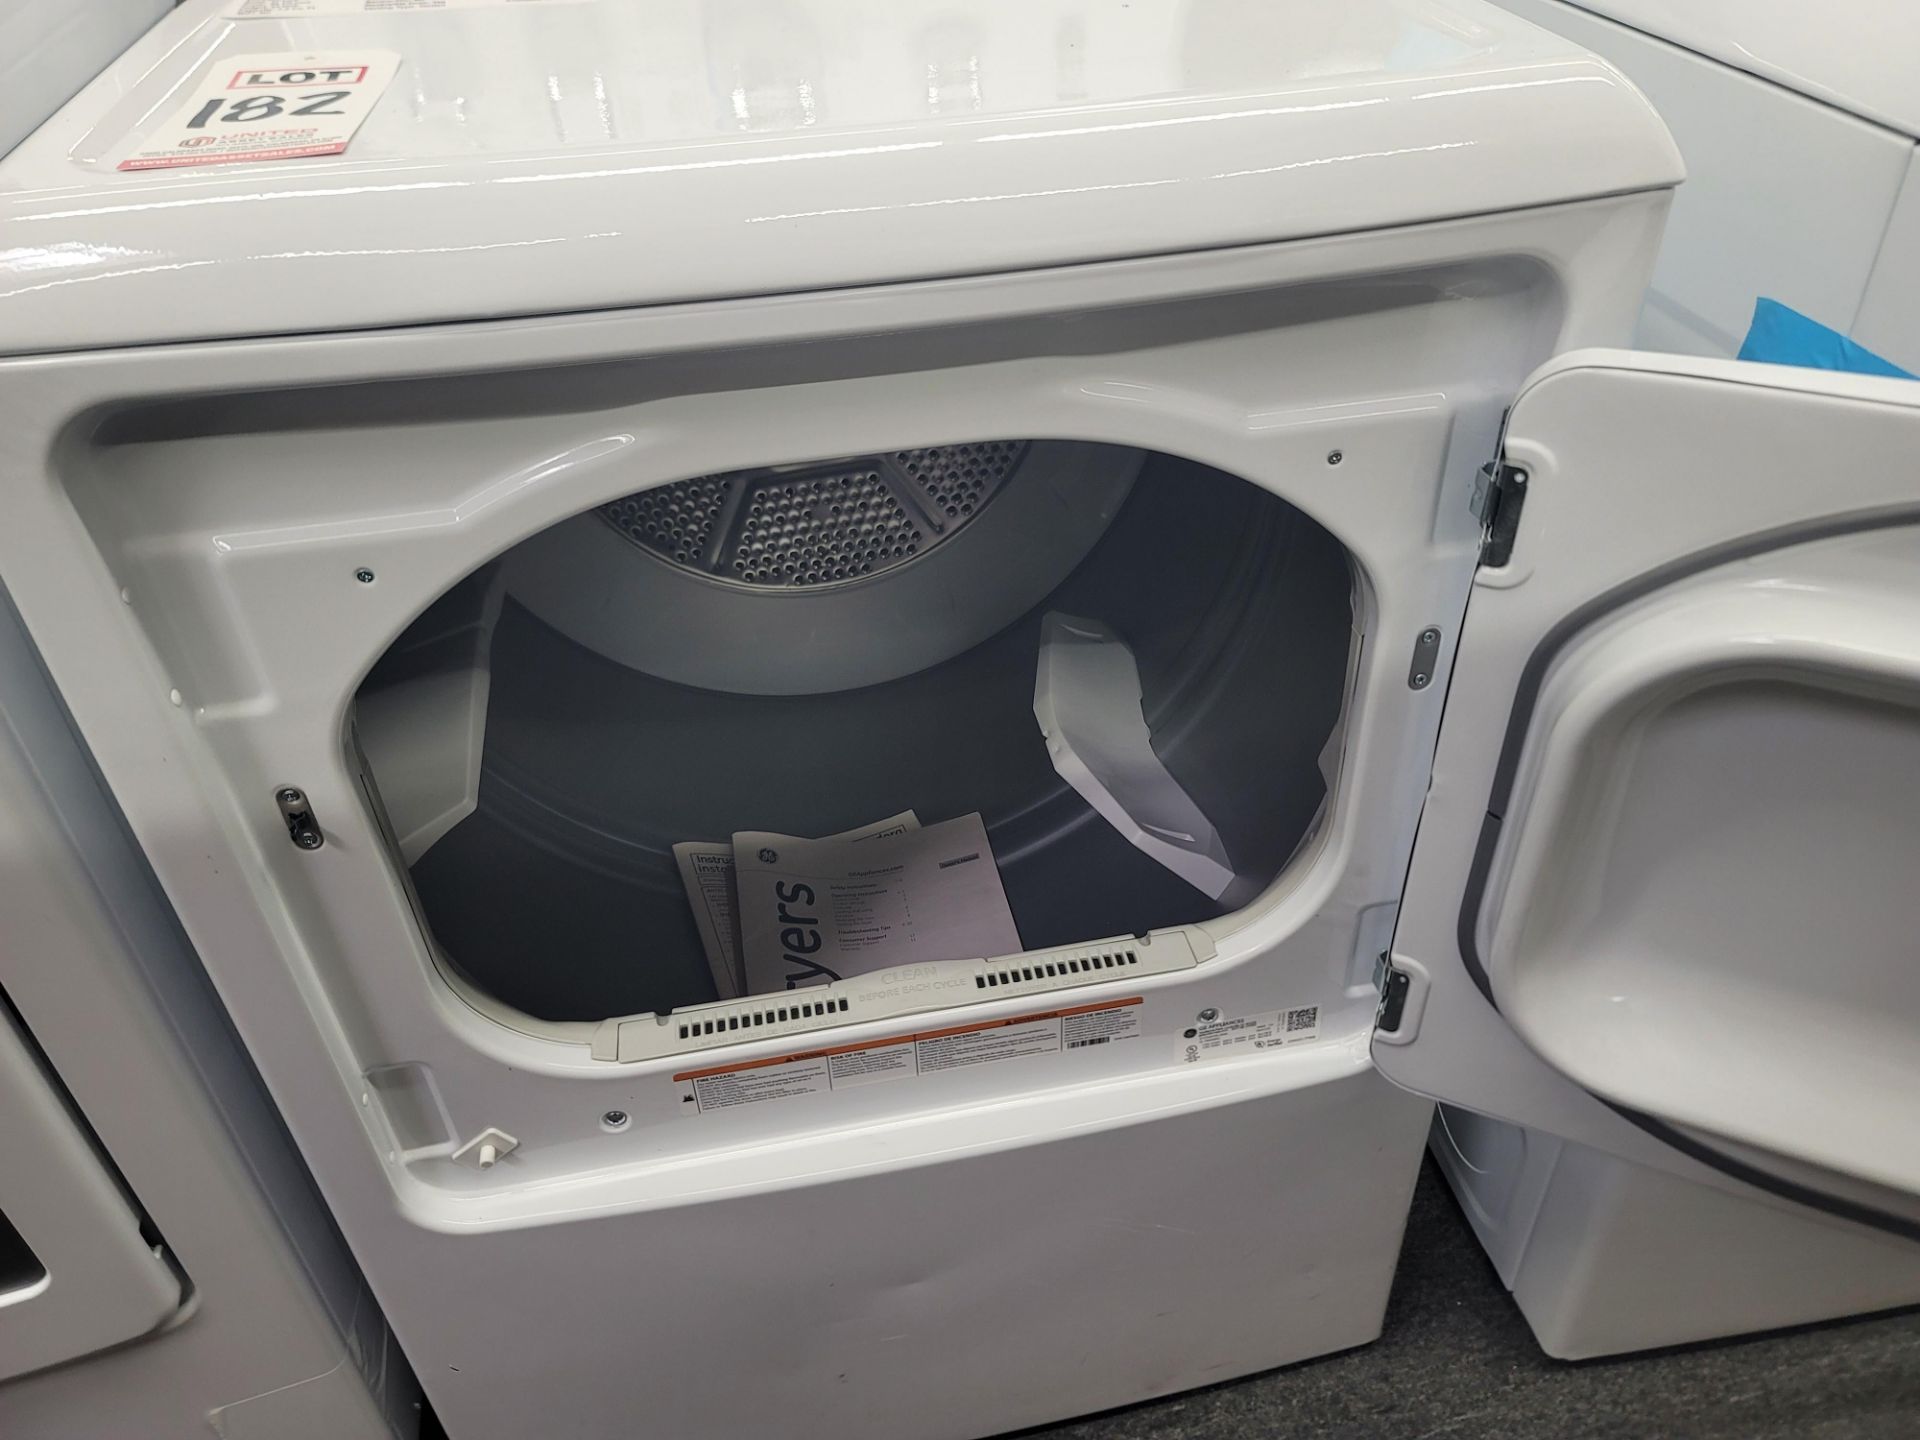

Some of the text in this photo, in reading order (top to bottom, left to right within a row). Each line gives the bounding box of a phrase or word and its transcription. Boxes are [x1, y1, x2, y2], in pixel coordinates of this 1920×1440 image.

[246, 70, 352, 85] LOT
[186, 91, 352, 129] 182
[220, 127, 319, 140] UNITED
[776, 881, 843, 990] yers
[881, 966, 938, 985] CLEAN
[859, 978, 968, 1002] BEFORE EACH CYCLE
